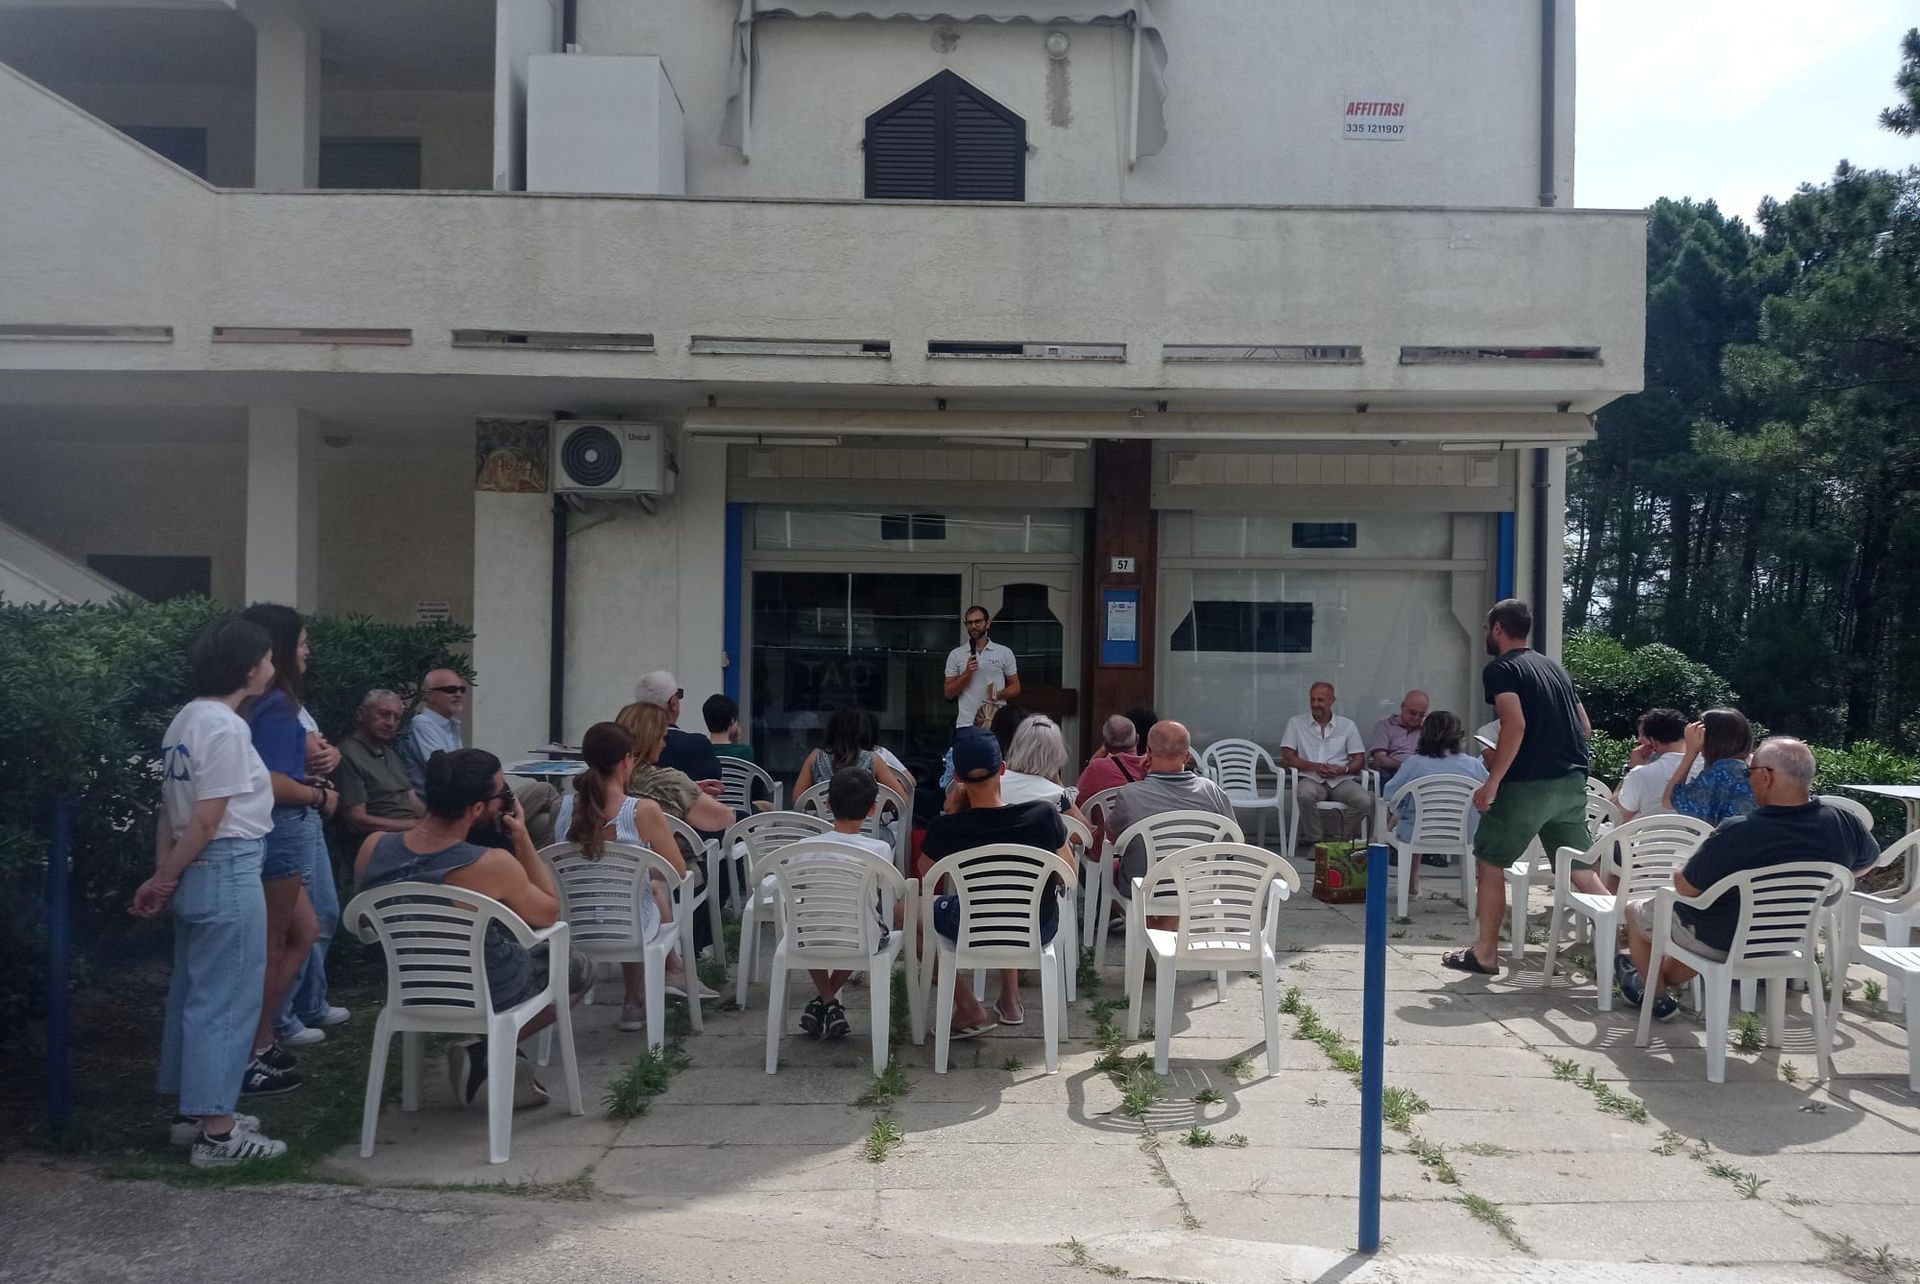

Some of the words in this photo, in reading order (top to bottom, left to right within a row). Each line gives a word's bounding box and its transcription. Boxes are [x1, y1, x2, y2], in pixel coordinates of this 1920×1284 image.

[1346, 102, 1405, 117] AFFITTASI
[1345, 124, 1364, 133] 335
[1367, 124, 1404, 134] 1211907
[1117, 560, 1128, 570] 57
